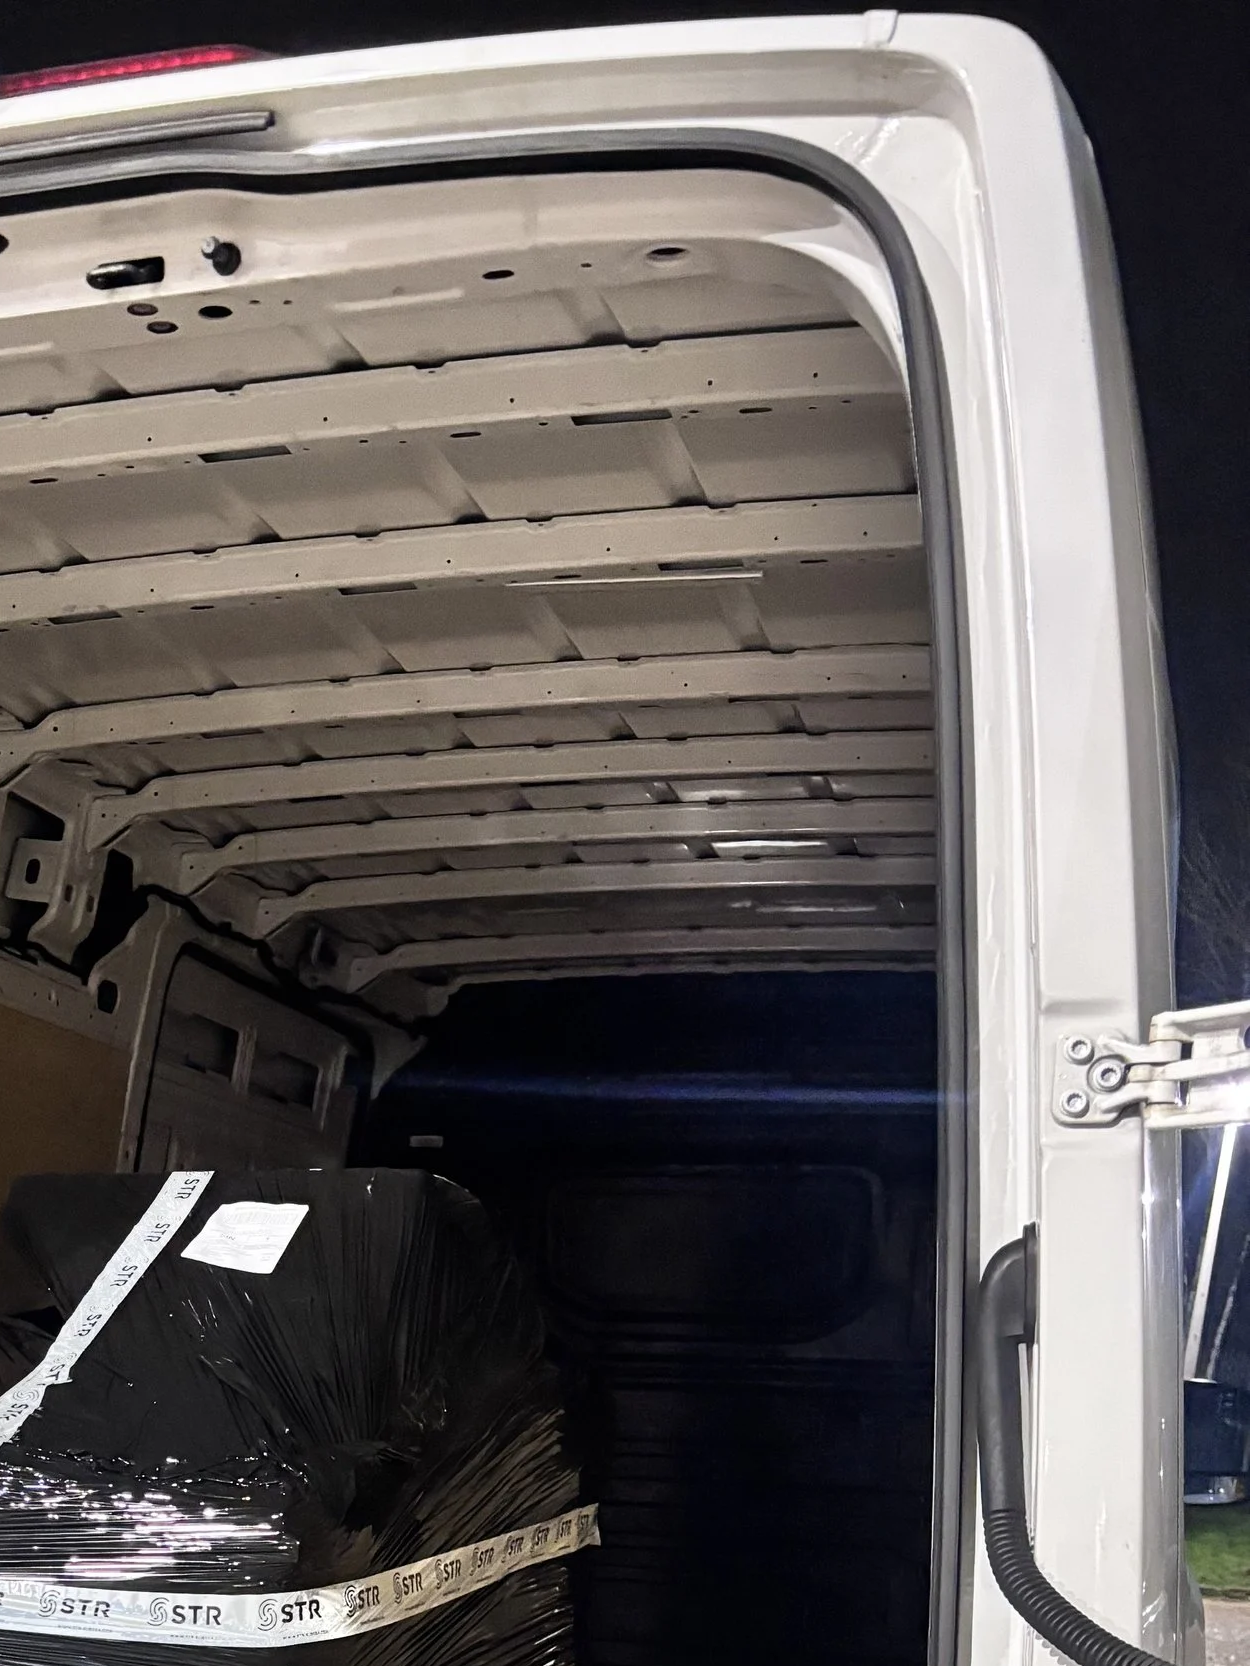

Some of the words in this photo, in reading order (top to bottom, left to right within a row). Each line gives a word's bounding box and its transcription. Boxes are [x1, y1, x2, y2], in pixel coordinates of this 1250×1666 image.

[175, 1178, 200, 1200] STR
[144, 1223, 170, 1243] STR
[110, 1265, 138, 1287] STR
[74, 1314, 102, 1337] STR
[60, 1597, 111, 1618] STR
[171, 1604, 222, 1627] STR
[281, 1599, 323, 1624] STR
[357, 1585, 380, 1610] STR
[402, 1573, 424, 1596] STR
[442, 1559, 462, 1582] STR
[477, 1547, 495, 1568] STR
[508, 1536, 525, 1555] STR
[535, 1526, 550, 1546] STR
[560, 1519, 573, 1538] STR
